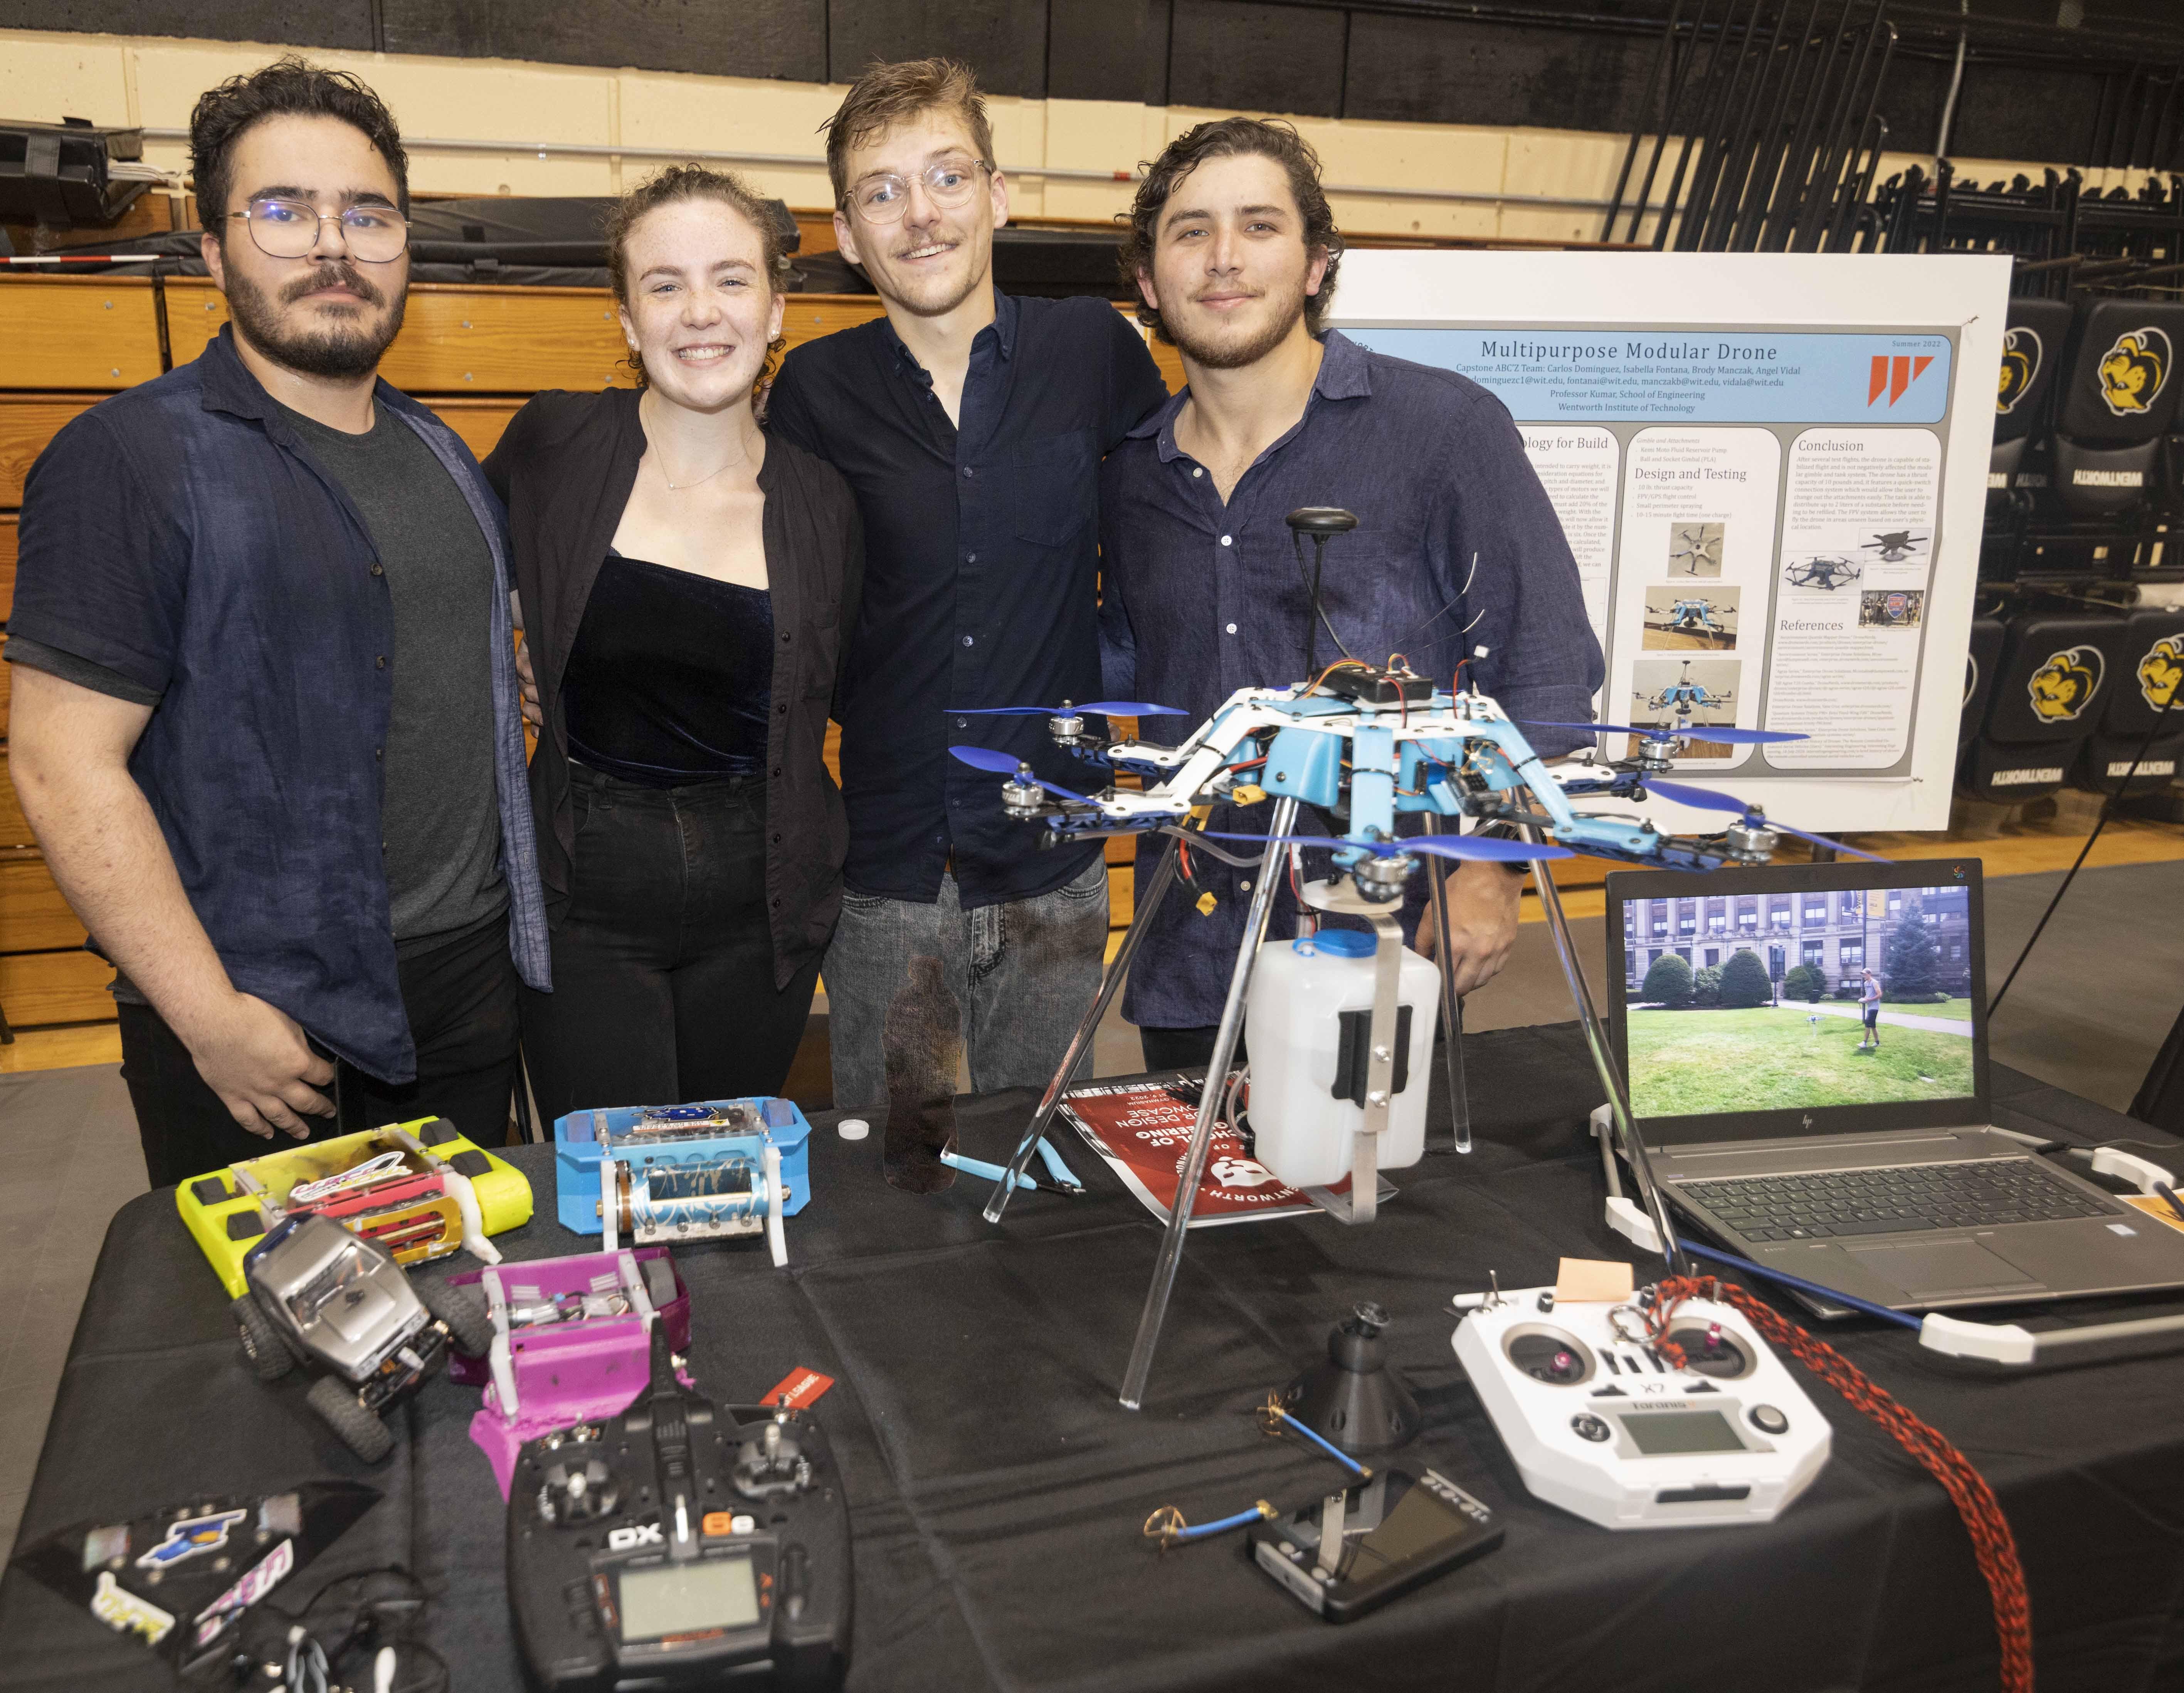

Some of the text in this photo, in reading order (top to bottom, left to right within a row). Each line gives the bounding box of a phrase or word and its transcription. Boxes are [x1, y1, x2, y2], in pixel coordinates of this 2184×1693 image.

[1481, 341, 1776, 362] Multipurpose Modular Drone
[1456, 364, 1493, 374] Capstone
[1495, 364, 1519, 372] ABC'Z
[1521, 364, 1545, 373] Team:
[1574, 365, 1621, 375] Dominguez,
[1656, 366, 1689, 375] Fontana,
[1692, 366, 1715, 376] Brody
[1717, 366, 1754, 375] Manczak,
[1755, 367, 1779, 376] Angel
[1567, 377, 1639, 387] fontanai@wit.edu,
[1641, 378, 1720, 387] manczakb@wit.edu,
[1722, 378, 1784, 388] vidala@wit.edu
[1550, 390, 1587, 398] Professor
[1590, 391, 1617, 399] Kumar,
[1619, 391, 1645, 399] School
[1657, 391, 1705, 401] Engineering
[1559, 403, 1602, 411] Wentworth
[1640, 404, 1648, 412] of
[1649, 404, 1695, 414] Technology
[1524, 437, 1607, 451] ology for Build
[1798, 440, 1863, 451] Conclusion
[1635, 469, 1746, 482] Design and Testing
[2073, 469, 2143, 487] WENTWORTH
[1780, 620, 1843, 630] References
[1991, 768, 2063, 786] WENTWORTH
[1127, 1097, 1169, 1106] GYMNASIUM
[1127, 1104, 1199, 1118] OWCASE
[1115, 1114, 1180, 1128] DESIGN
[1150, 1137, 1174, 1147] OF
[1209, 1186, 1299, 1202] ENTWORTH
[1640, 1383, 1664, 1393] X7
[608, 1522, 663, 1551] DX
